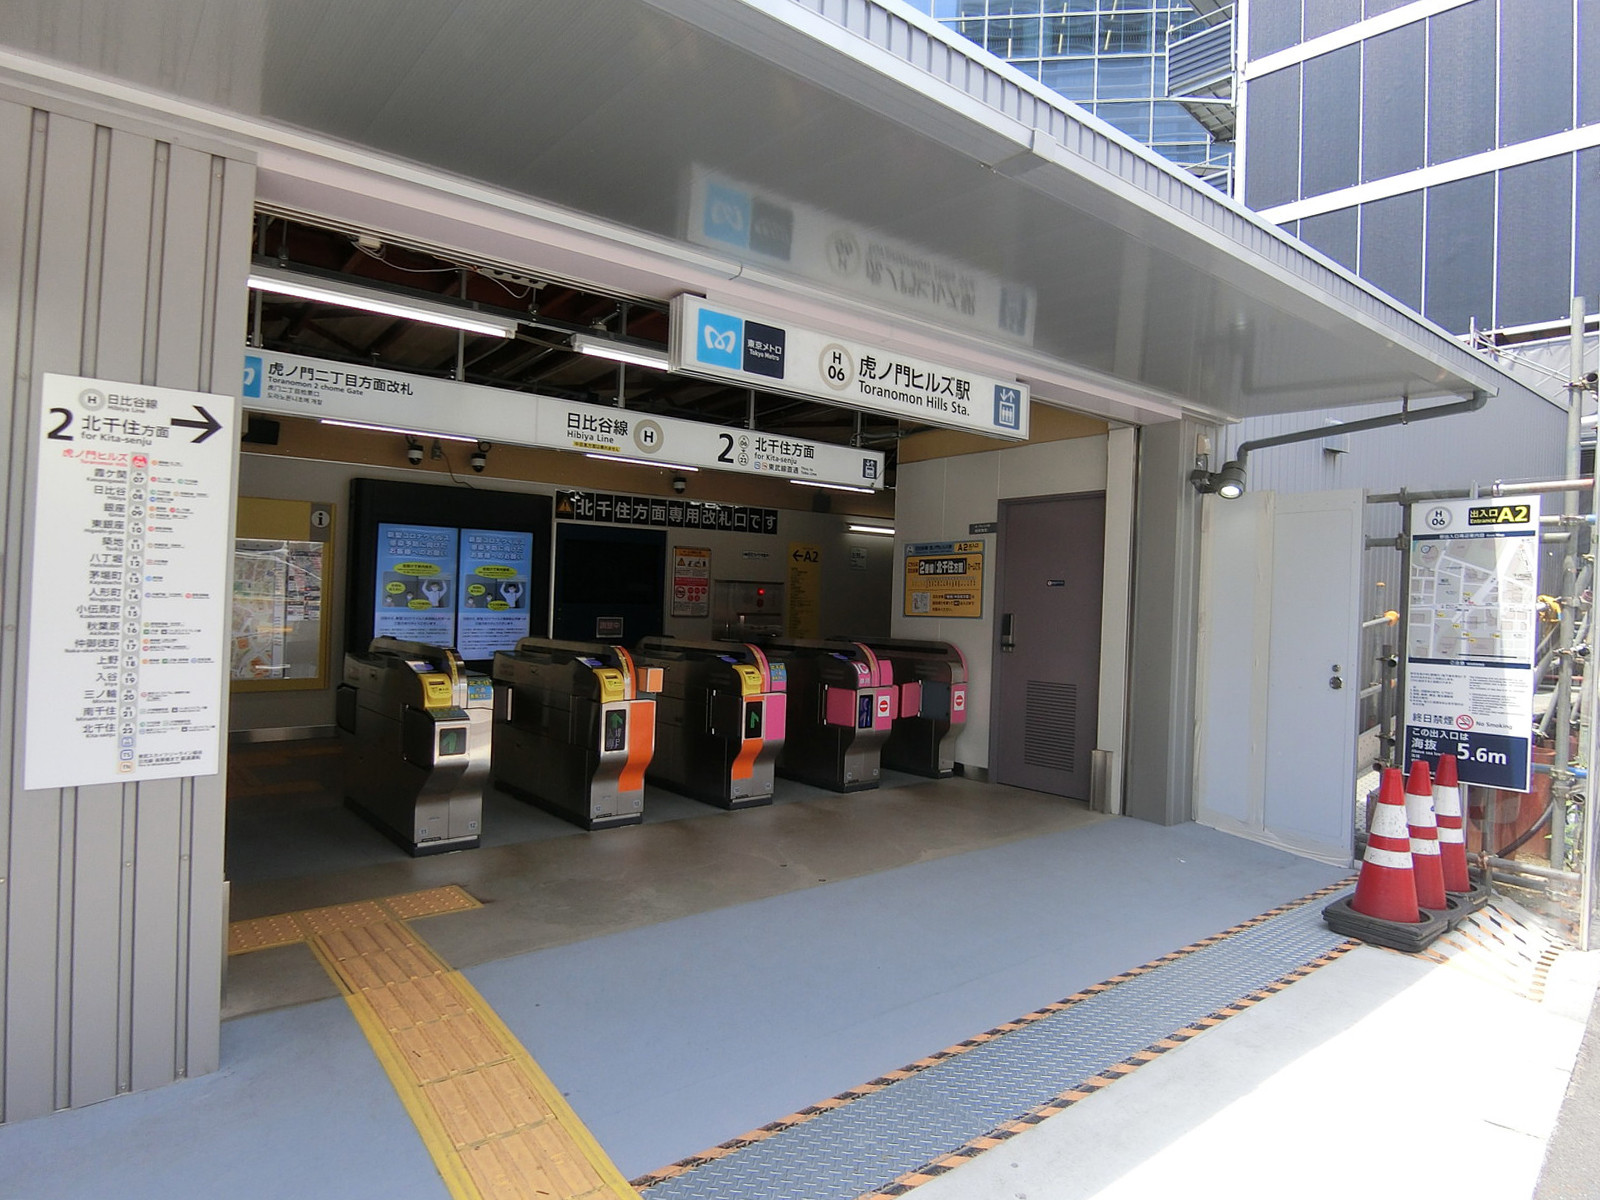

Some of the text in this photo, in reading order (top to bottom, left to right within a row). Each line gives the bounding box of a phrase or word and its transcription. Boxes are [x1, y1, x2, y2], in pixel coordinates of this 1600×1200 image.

[748, 339, 782, 354] 東京メトロ
[750, 348, 780, 361] Tokyo Metro
[833, 352, 842, 365] H
[268, 362, 414, 396] 虎ノ門二丁目方面改札
[828, 366, 845, 381] 06
[859, 356, 970, 401] 虎ノ門ヒルズ駅
[268, 376, 312, 389] Toranomon
[320, 383, 345, 394] chome
[346, 386, 364, 396] Gate
[108, 394, 158, 410] 日比谷線
[858, 380, 970, 416] Toranomon Hills Sta.
[47, 407, 74, 441] 2
[82, 415, 170, 438] 北千住方面
[567, 412, 628, 436] 日比谷線
[81, 431, 152, 446] for Kita-senju
[567, 430, 614, 444] Hibiya Line
[643, 430, 654, 443] H
[718, 433, 734, 463] 2
[755, 437, 815, 459] 北千住方面
[62, 448, 128, 462] 虎ノ門ヒルズ
[754, 452, 798, 465] for Kita-senju
[769, 463, 799, 474] 東武線直通
[94, 485, 126, 496] 日比谷
[104, 503, 125, 513] 銀座
[577, 499, 777, 530] 北千住方面専用改札口です
[1470, 509, 1498, 518] 出入口
[1497, 506, 1528, 523] A2
[92, 520, 125, 529] 東銀座
[804, 550, 819, 563] A2
[89, 588, 121, 598] 人形町
[76, 605, 121, 614] 小伝馬町
[87, 622, 120, 631] 秋葉原
[97, 656, 118, 665] 上野
[96, 672, 118, 682] 入谷
[84, 690, 117, 699] 三ノ輪
[83, 706, 116, 716] 南千住
[1412, 713, 1454, 725] 終日禁煙
[83, 724, 116, 733] 北千住
[1486, 722, 1512, 730] Smoking
[1412, 728, 1469, 740] この出入口は
[1411, 738, 1437, 751] 海抜
[1457, 743, 1507, 765] 5.6m
